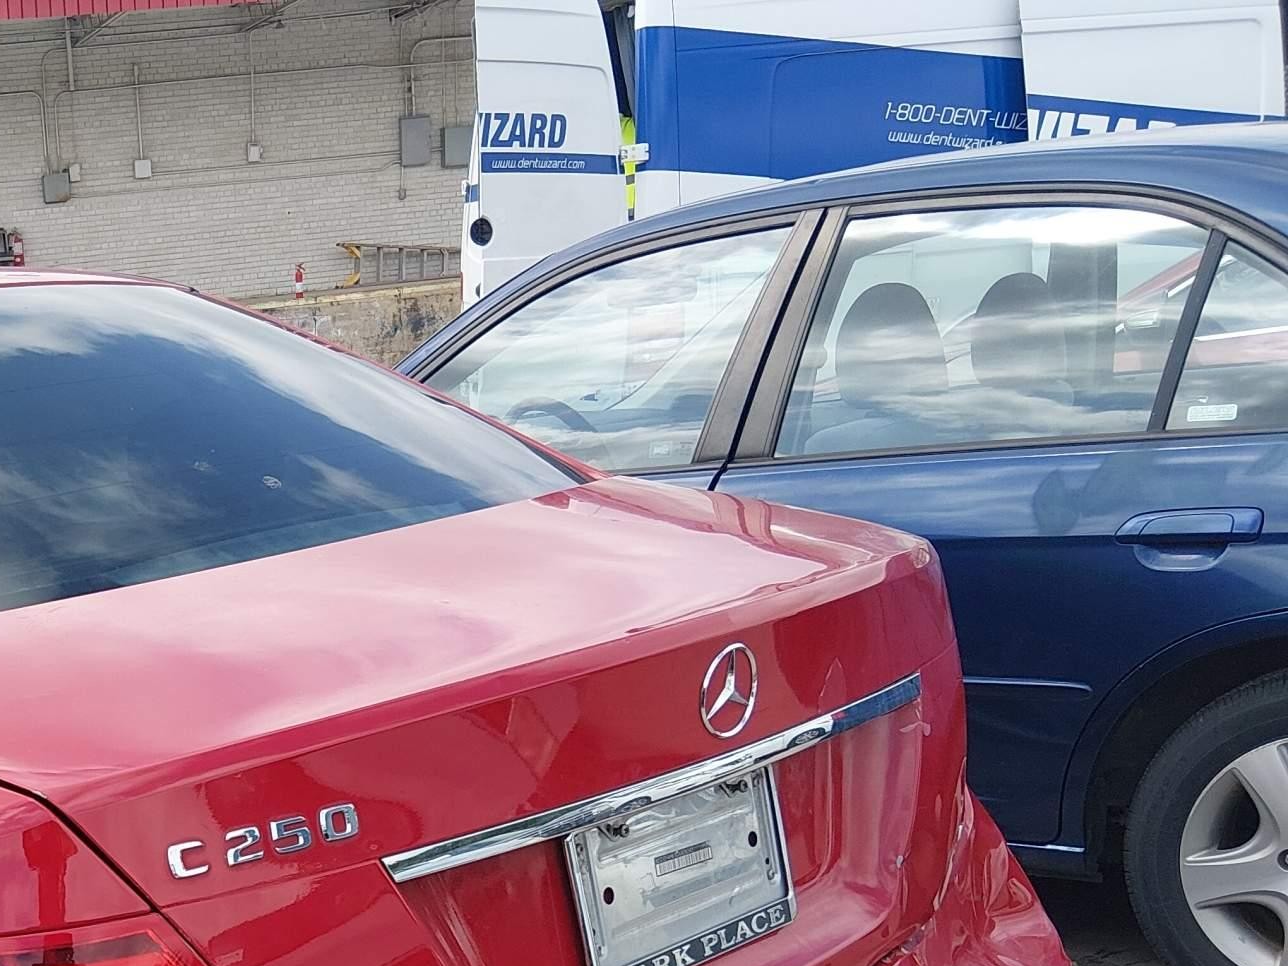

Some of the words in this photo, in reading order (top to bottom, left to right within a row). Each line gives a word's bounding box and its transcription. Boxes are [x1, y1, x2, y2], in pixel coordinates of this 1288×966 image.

[479, 112, 568, 148] IZARD
[491, 157, 586, 169] www.dentwizard.com
[167, 840, 210, 879] C
[225, 803, 359, 867] 250
[701, 904, 785, 956] PLACE
